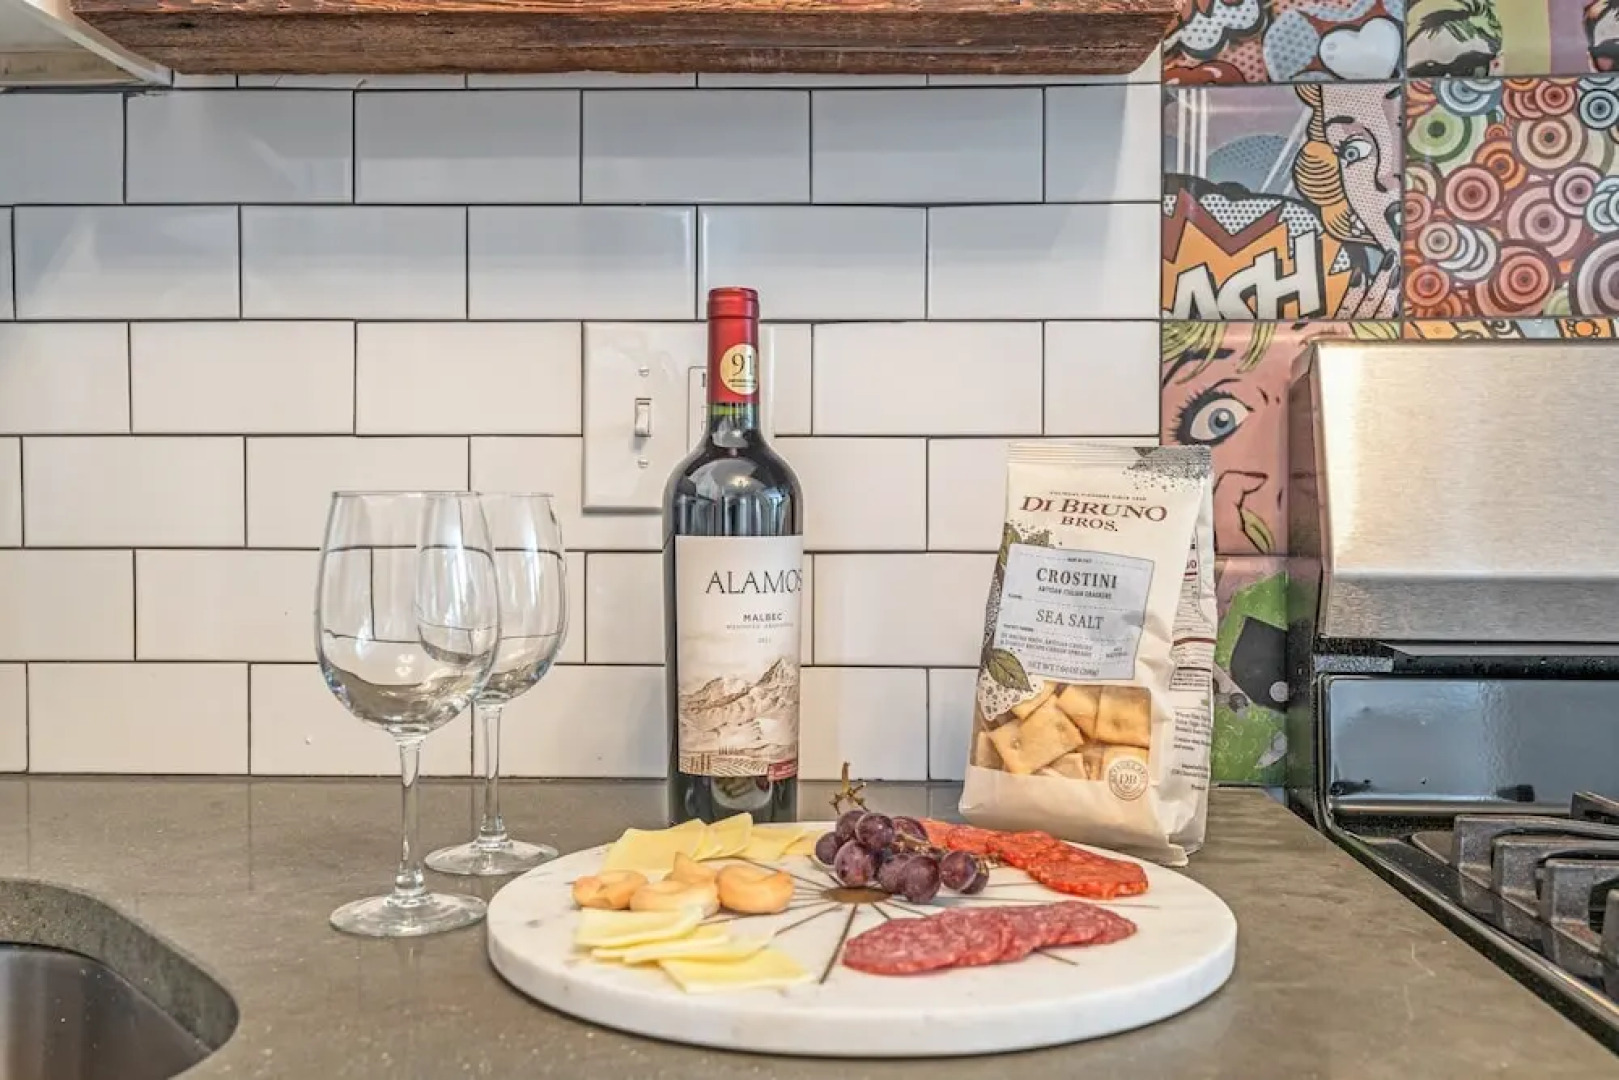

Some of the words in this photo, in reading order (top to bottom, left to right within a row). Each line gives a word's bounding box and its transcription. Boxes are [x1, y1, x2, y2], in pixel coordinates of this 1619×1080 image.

[731, 352, 753, 376] 91
[1019, 496, 1055, 512] DI
[1057, 498, 1168, 522] BRUNO
[1059, 516, 1118, 532] BROS.
[1036, 568, 1118, 589] CROSTINI
[742, 612, 784, 623] MALBEC
[1036, 608, 1065, 626] SEA
[1068, 612, 1105, 631] SALT
